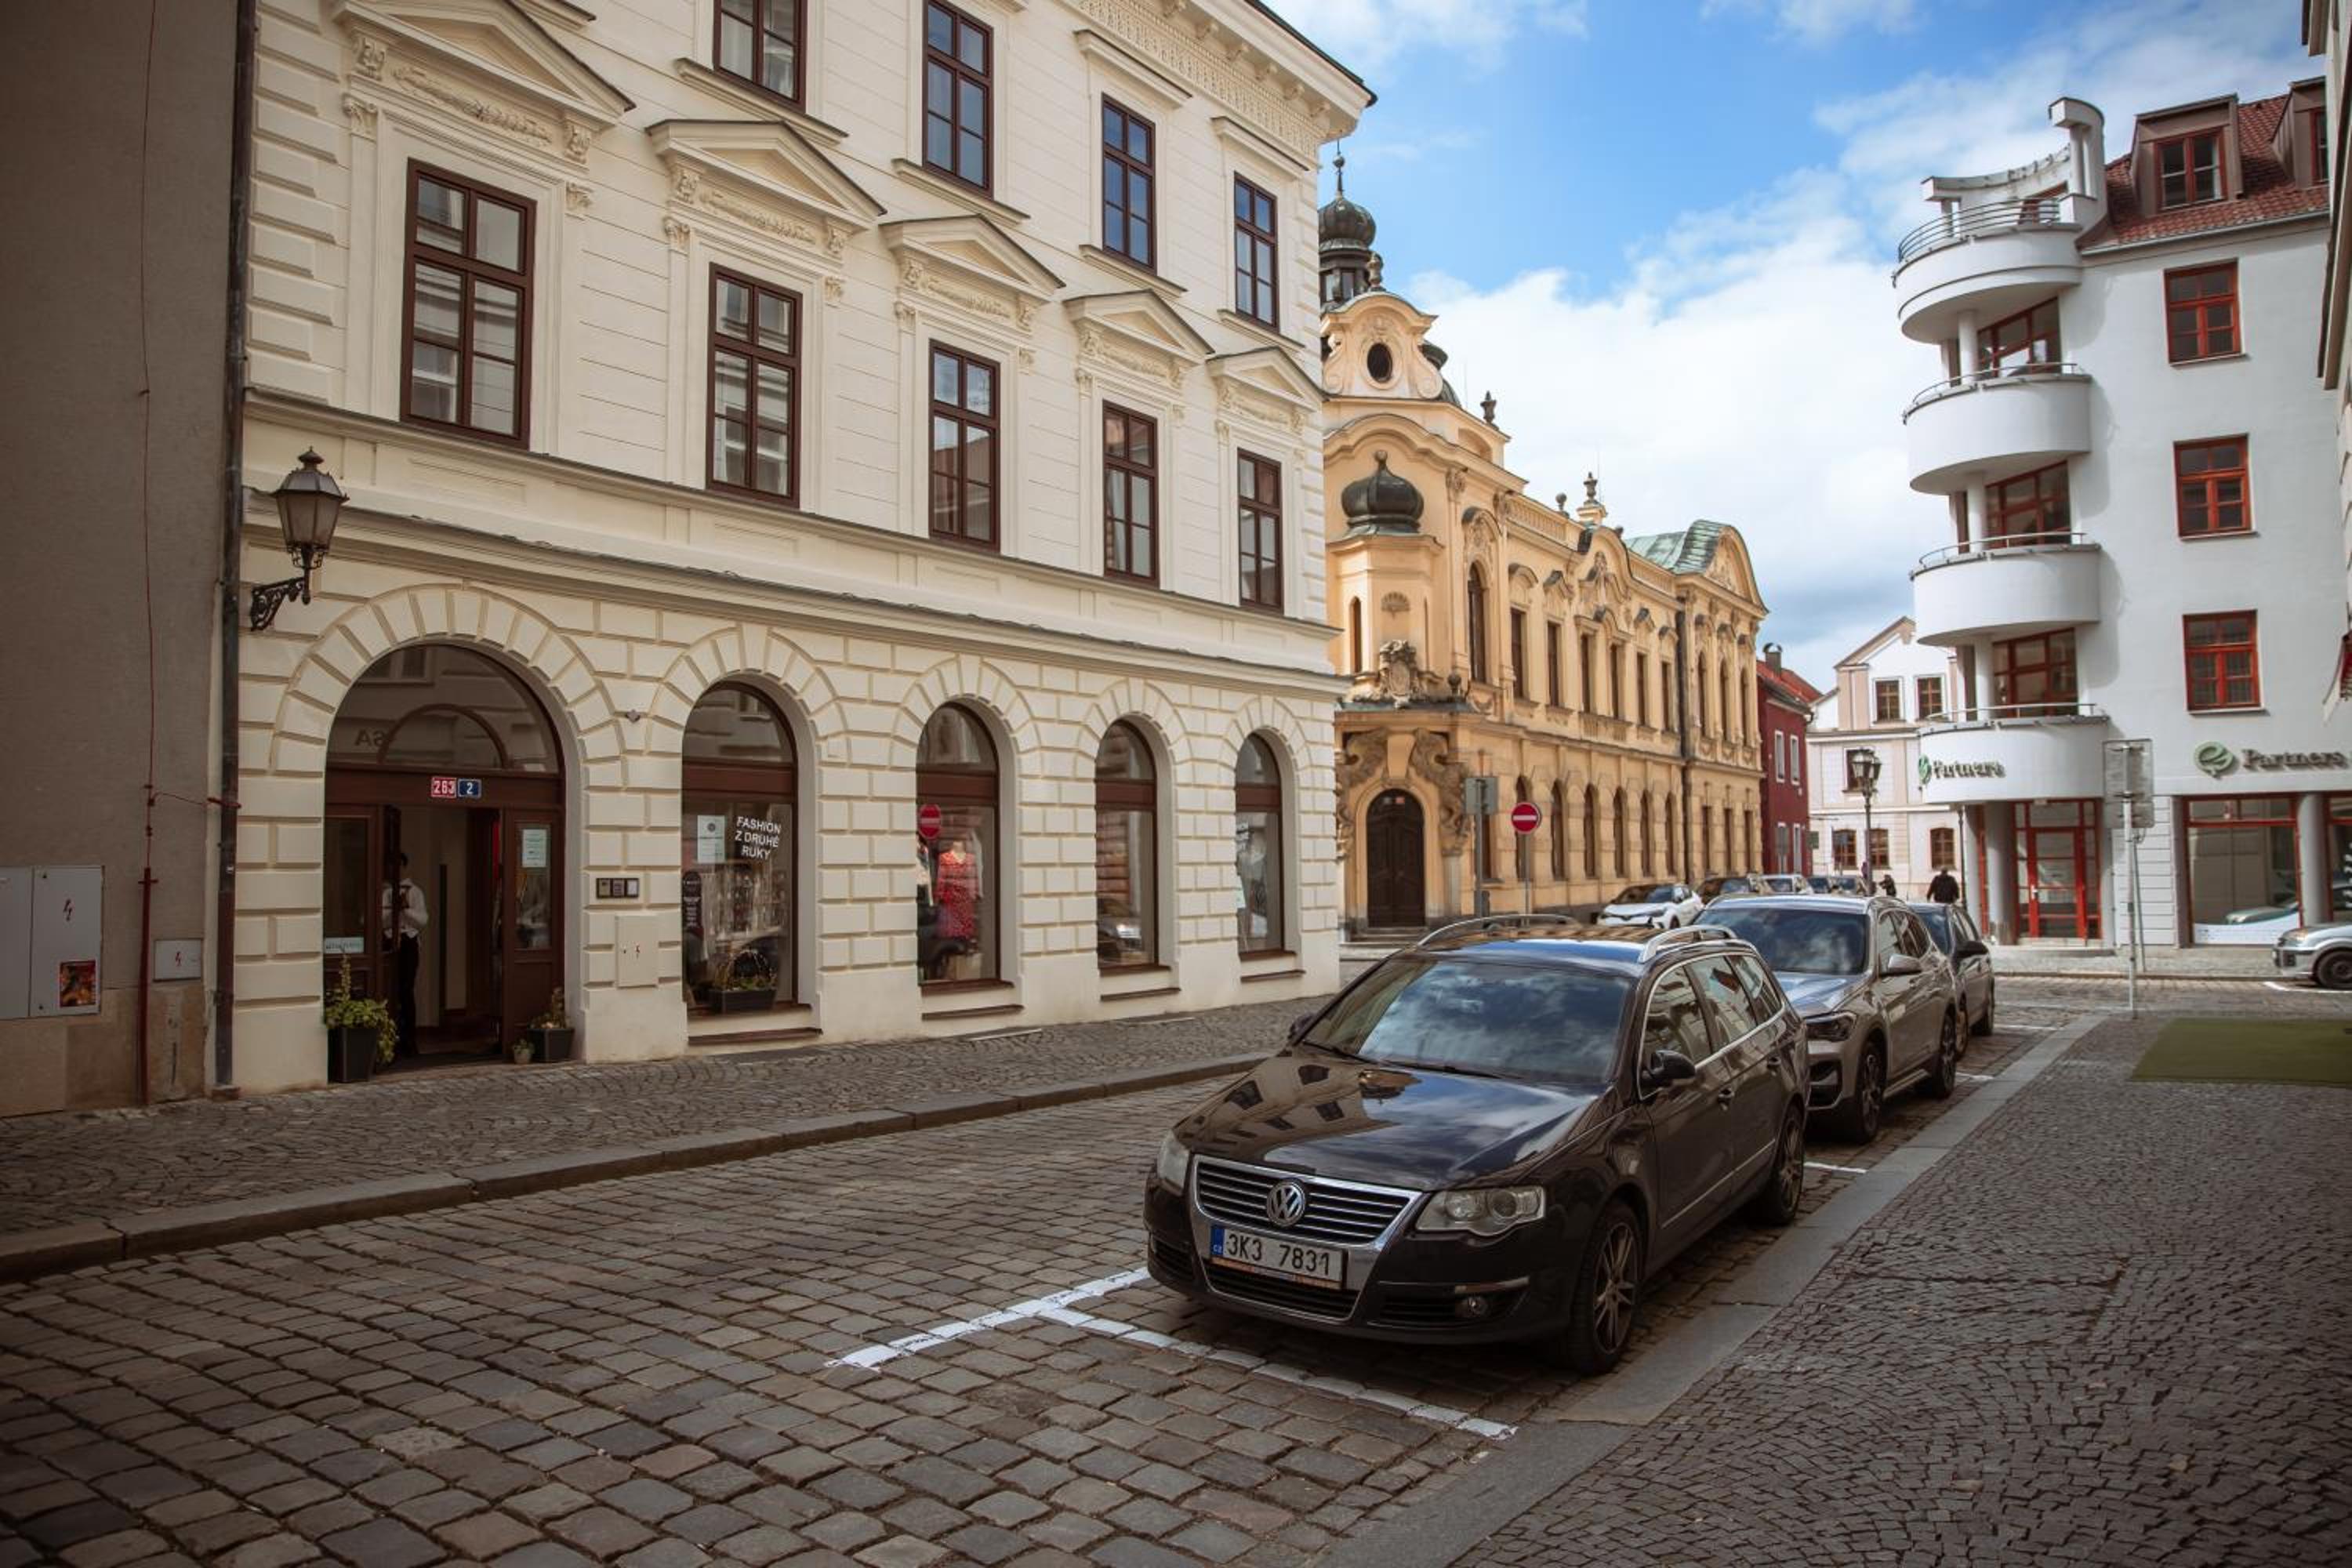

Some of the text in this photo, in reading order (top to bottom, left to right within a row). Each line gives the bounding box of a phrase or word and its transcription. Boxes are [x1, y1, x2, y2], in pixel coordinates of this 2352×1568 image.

[2241, 749, 2348, 771] Partners
[1932, 760, 2006, 779] Partners
[434, 780, 455, 794] 263
[736, 816, 782, 834] FASHION
[735, 830, 742, 841] Z
[741, 845, 771, 860] RUKY
[1227, 1233, 1263, 1261] 3K3
[1278, 1243, 1330, 1276] 7831
